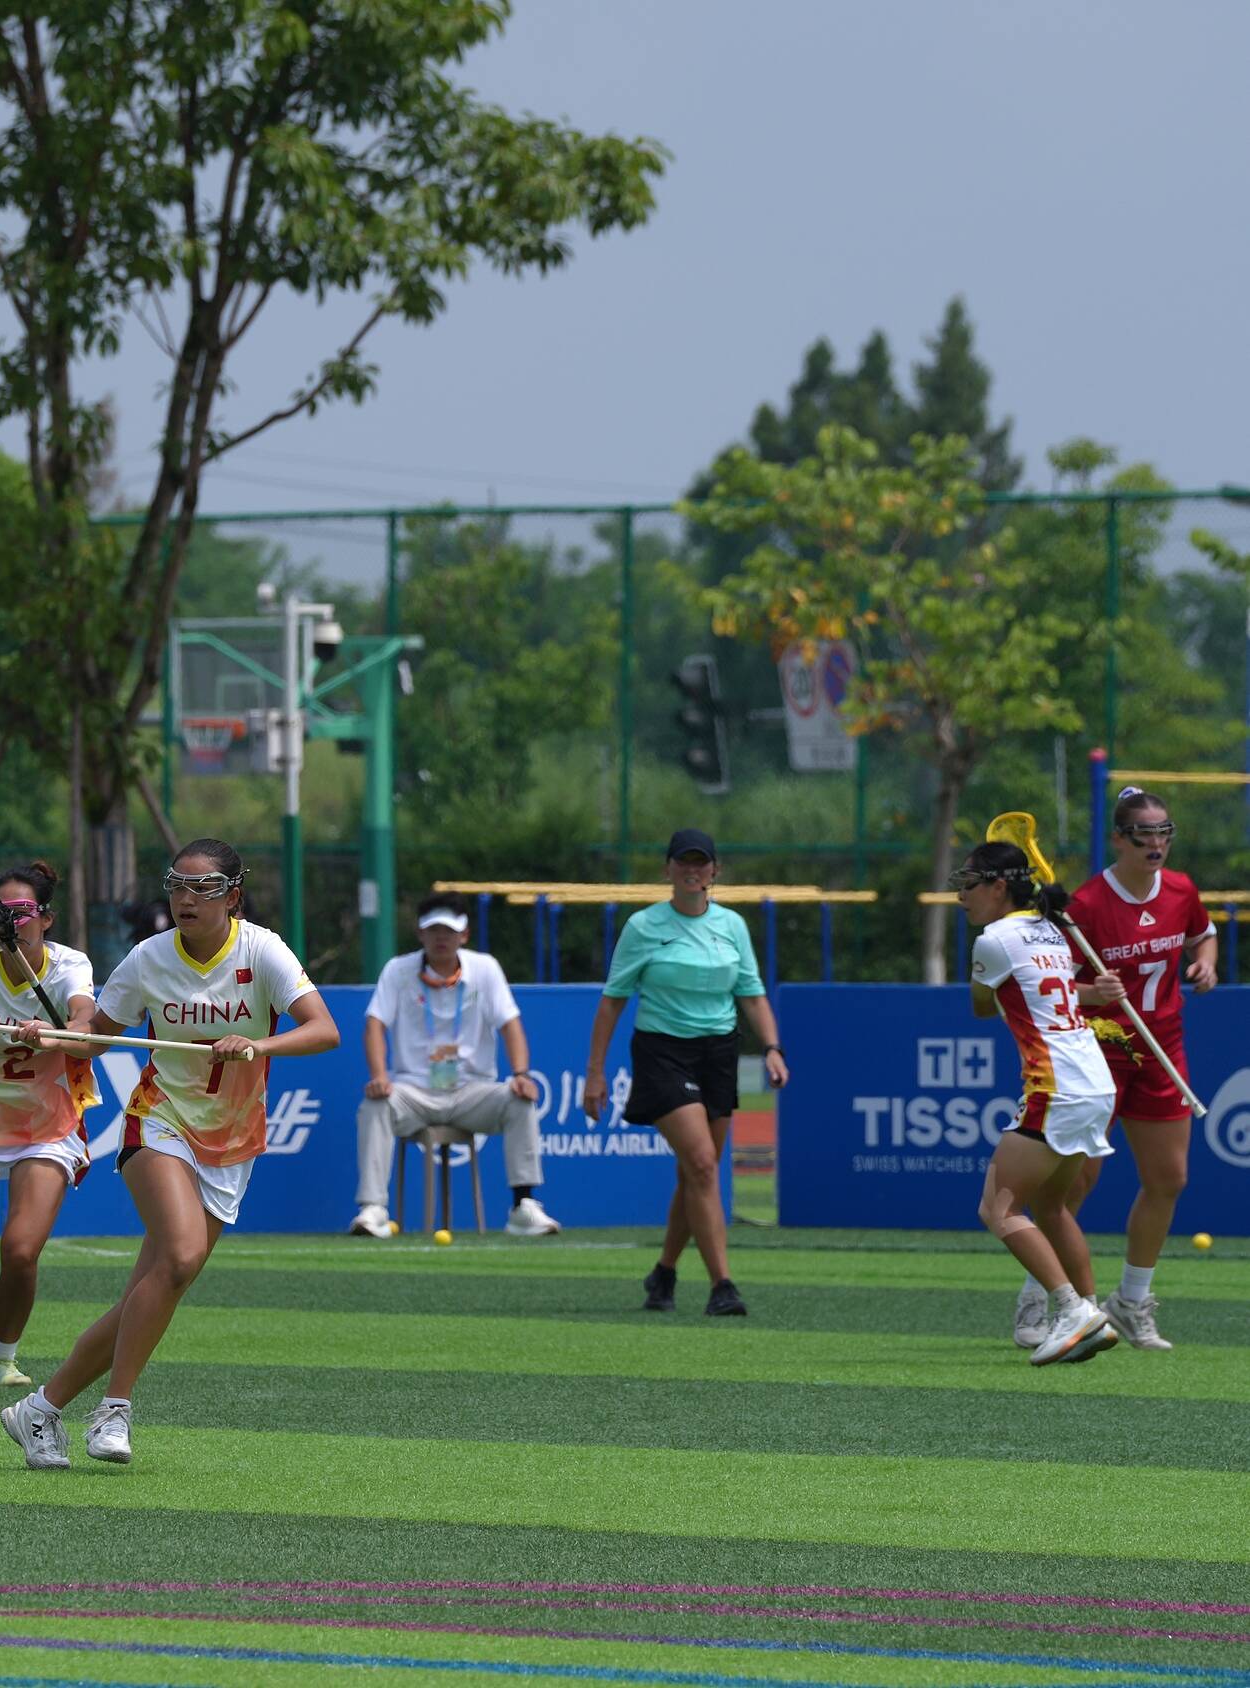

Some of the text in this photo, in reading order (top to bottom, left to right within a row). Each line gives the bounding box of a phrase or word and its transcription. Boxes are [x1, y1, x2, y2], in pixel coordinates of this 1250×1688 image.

[1102, 941, 1148, 961] GREAT
[1138, 960, 1167, 1012] 7
[162, 999, 252, 1025] CHINA
[2, 1046, 35, 1079] 2
[265, 1088, 321, 1154] 步
[852, 1096, 1019, 1148] TISSO
[538, 1133, 675, 1157] HUAN AIRLIN
[852, 1155, 900, 1173] SWISS
[903, 1155, 975, 1174] WATCHES
